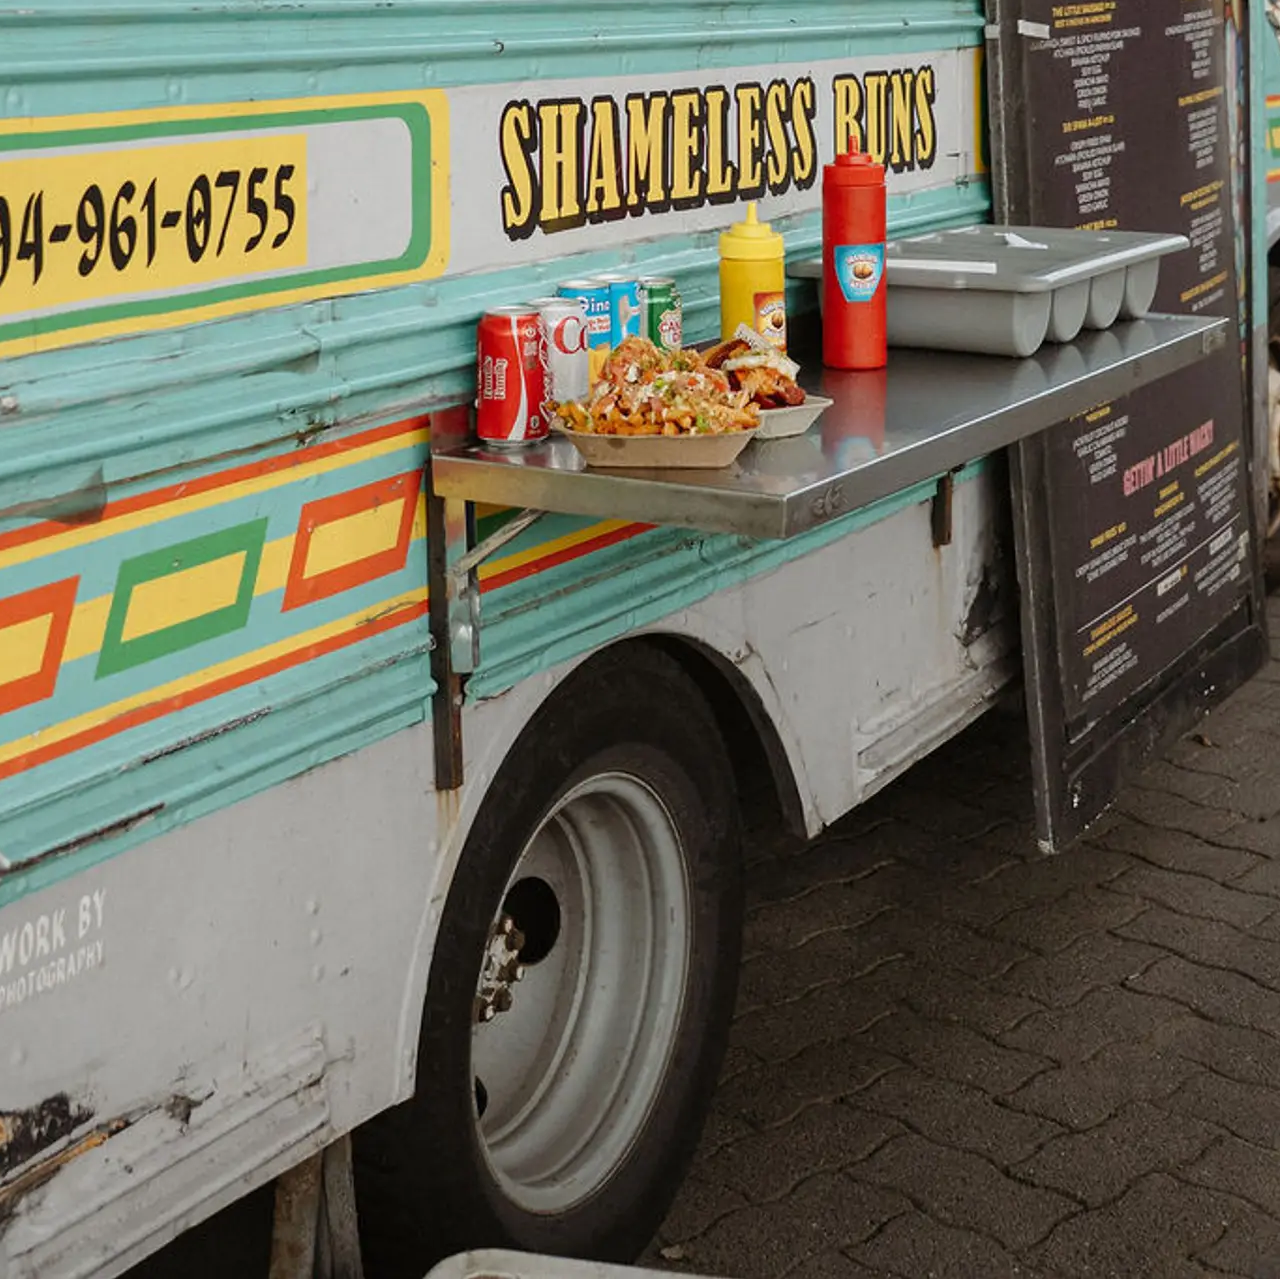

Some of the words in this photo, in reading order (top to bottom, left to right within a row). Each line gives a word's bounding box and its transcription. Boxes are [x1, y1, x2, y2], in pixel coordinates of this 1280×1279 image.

[500, 76, 817, 240] SHAMELESS
[833, 65, 938, 174] BUNS
[77, 887, 108, 937] BY
